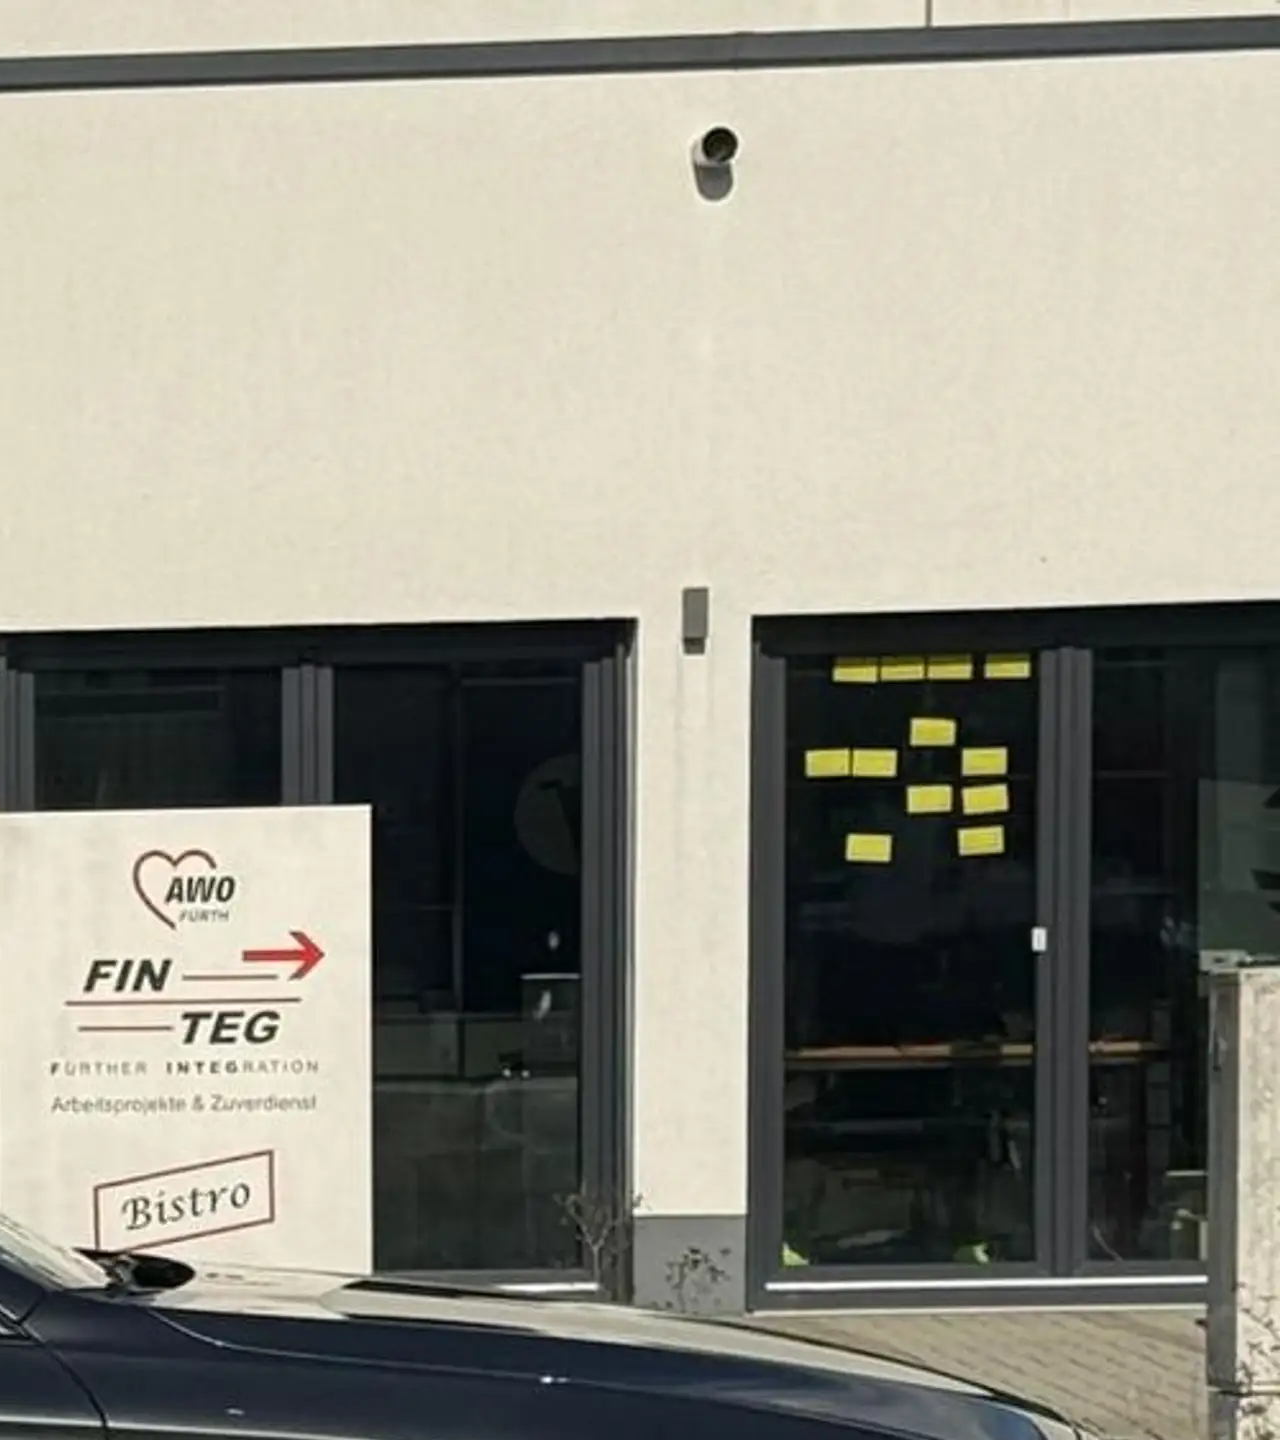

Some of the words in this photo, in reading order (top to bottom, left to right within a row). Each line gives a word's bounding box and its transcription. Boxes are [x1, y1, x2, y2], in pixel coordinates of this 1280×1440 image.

[164, 875, 236, 904] AWO
[83, 958, 172, 993] FIN
[181, 1010, 281, 1045] TEG
[165, 1059, 319, 1075] INTEGRATION
[191, 1094, 205, 1112] &
[121, 1182, 251, 1231] Bistro
